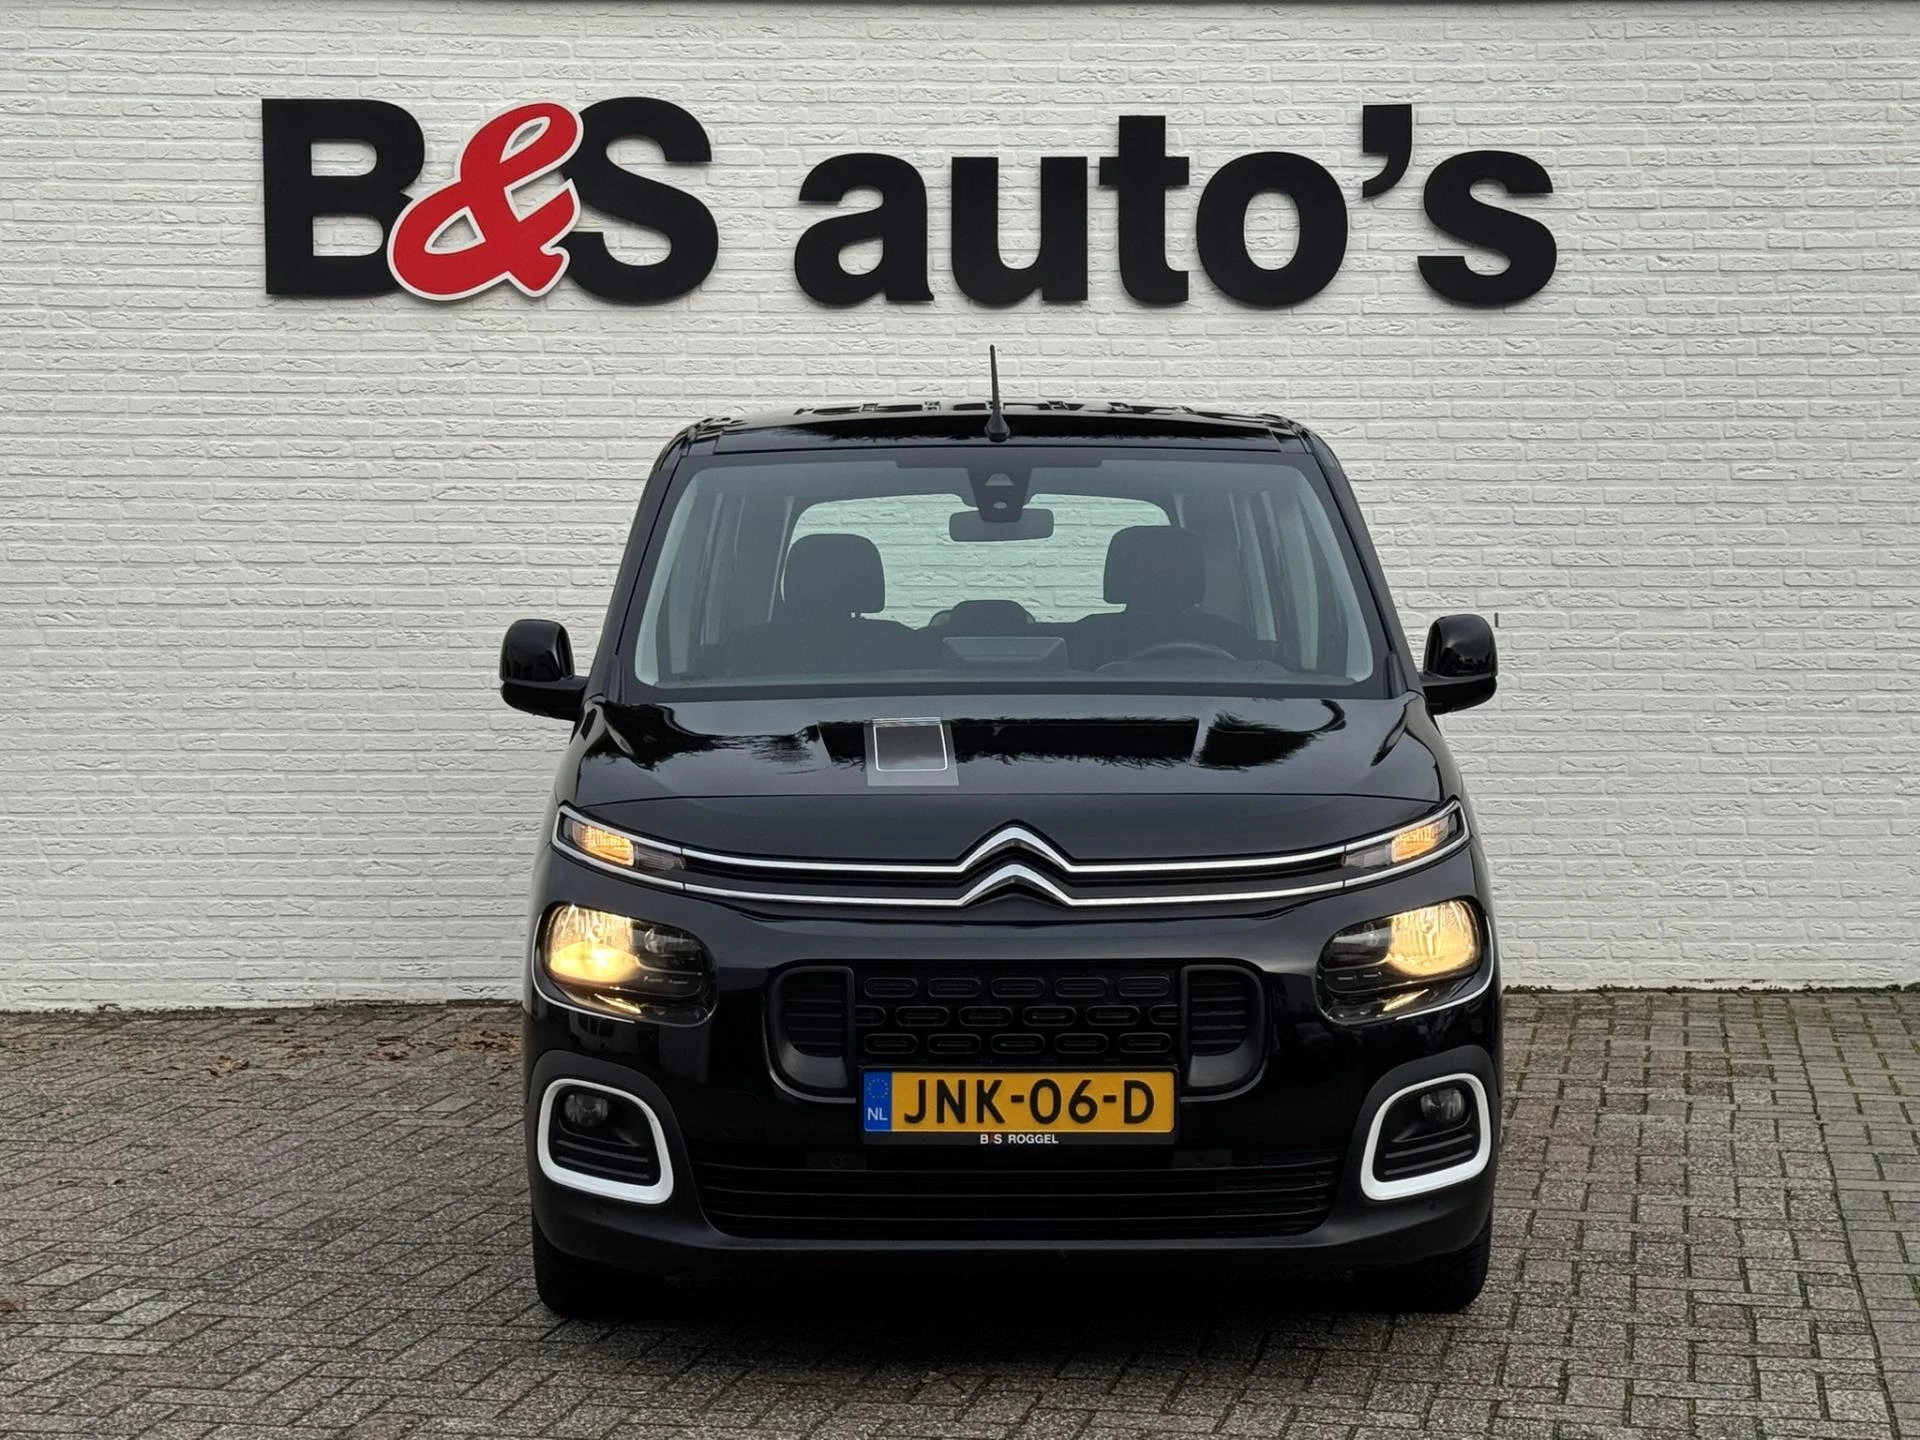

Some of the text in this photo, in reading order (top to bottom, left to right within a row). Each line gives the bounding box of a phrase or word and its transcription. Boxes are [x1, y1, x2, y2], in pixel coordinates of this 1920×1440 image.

[261, 96, 1557, 309] B&S auto's
[867, 1107, 887, 1121] NL
[903, 1078, 1155, 1125] JNK-06-D
[1008, 1134, 1059, 1144] ROGGEL
